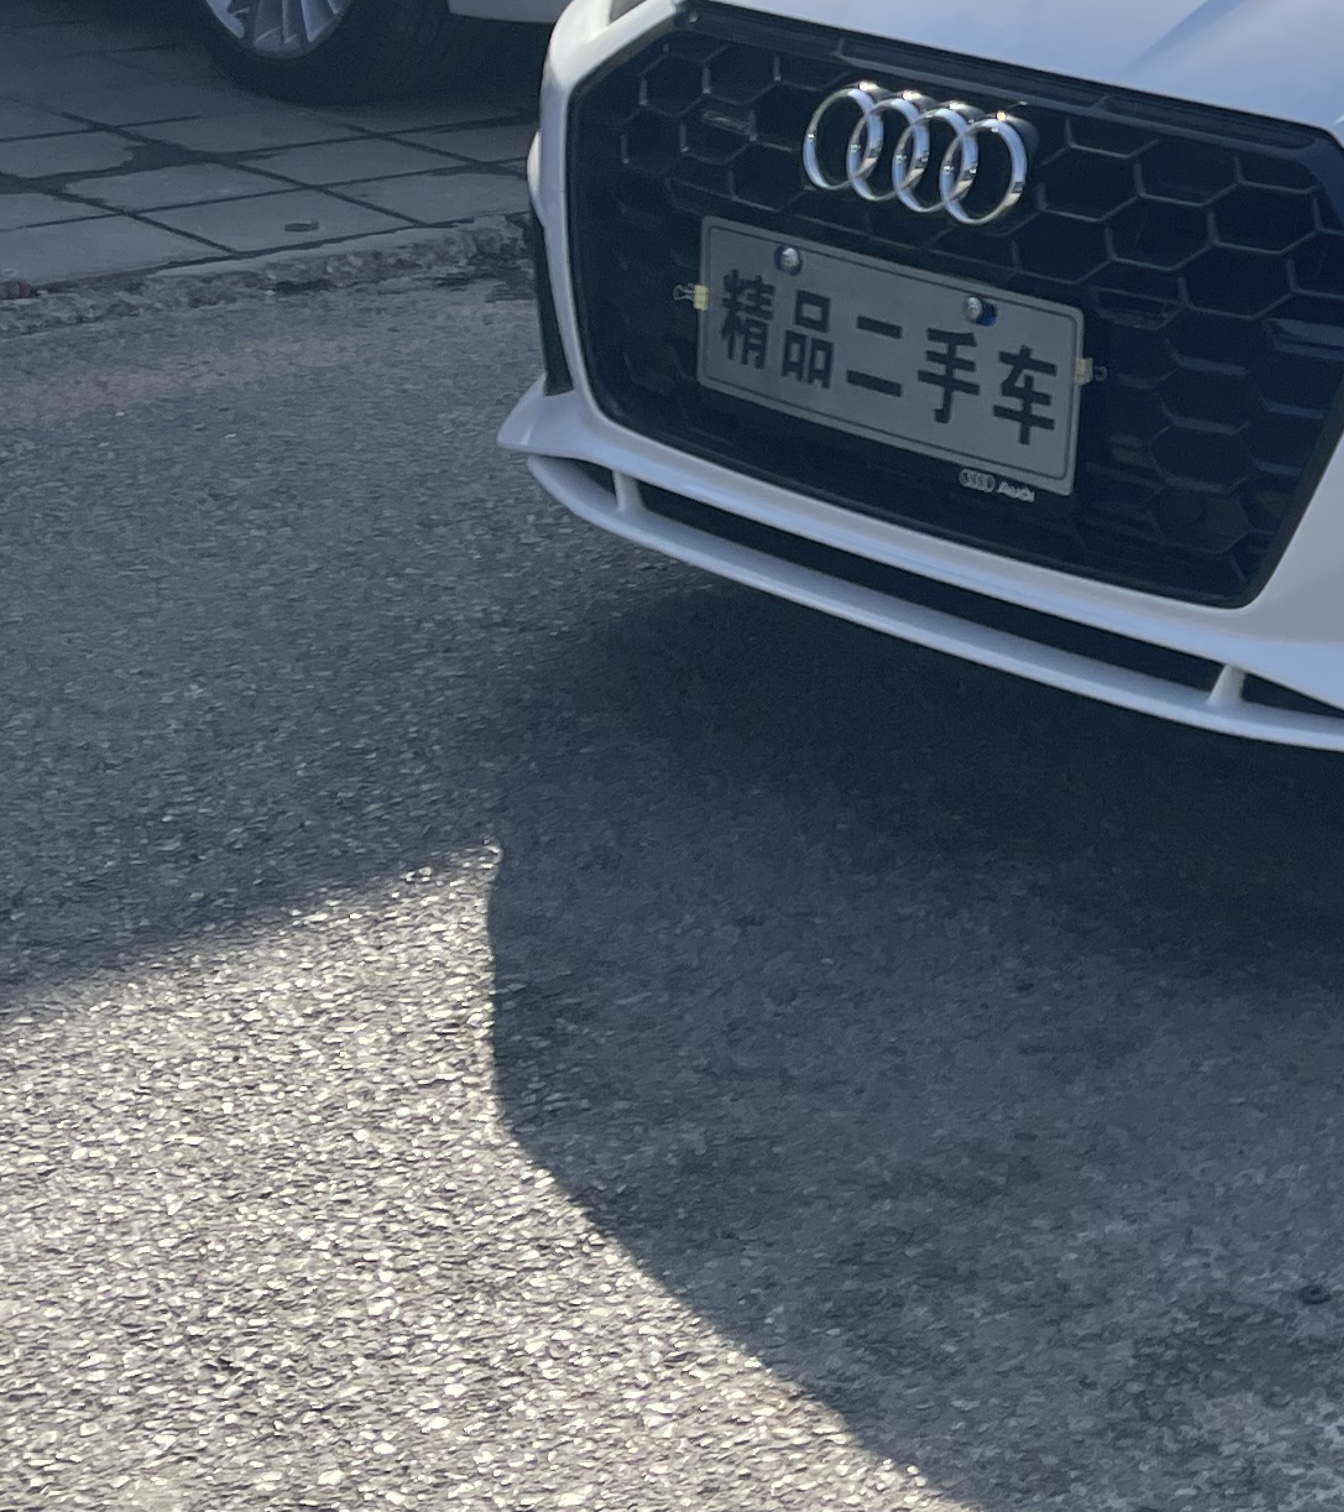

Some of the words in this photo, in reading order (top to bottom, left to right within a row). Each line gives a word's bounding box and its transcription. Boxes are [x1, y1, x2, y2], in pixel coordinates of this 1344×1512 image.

[720, 269, 1058, 445] 精品二手车
